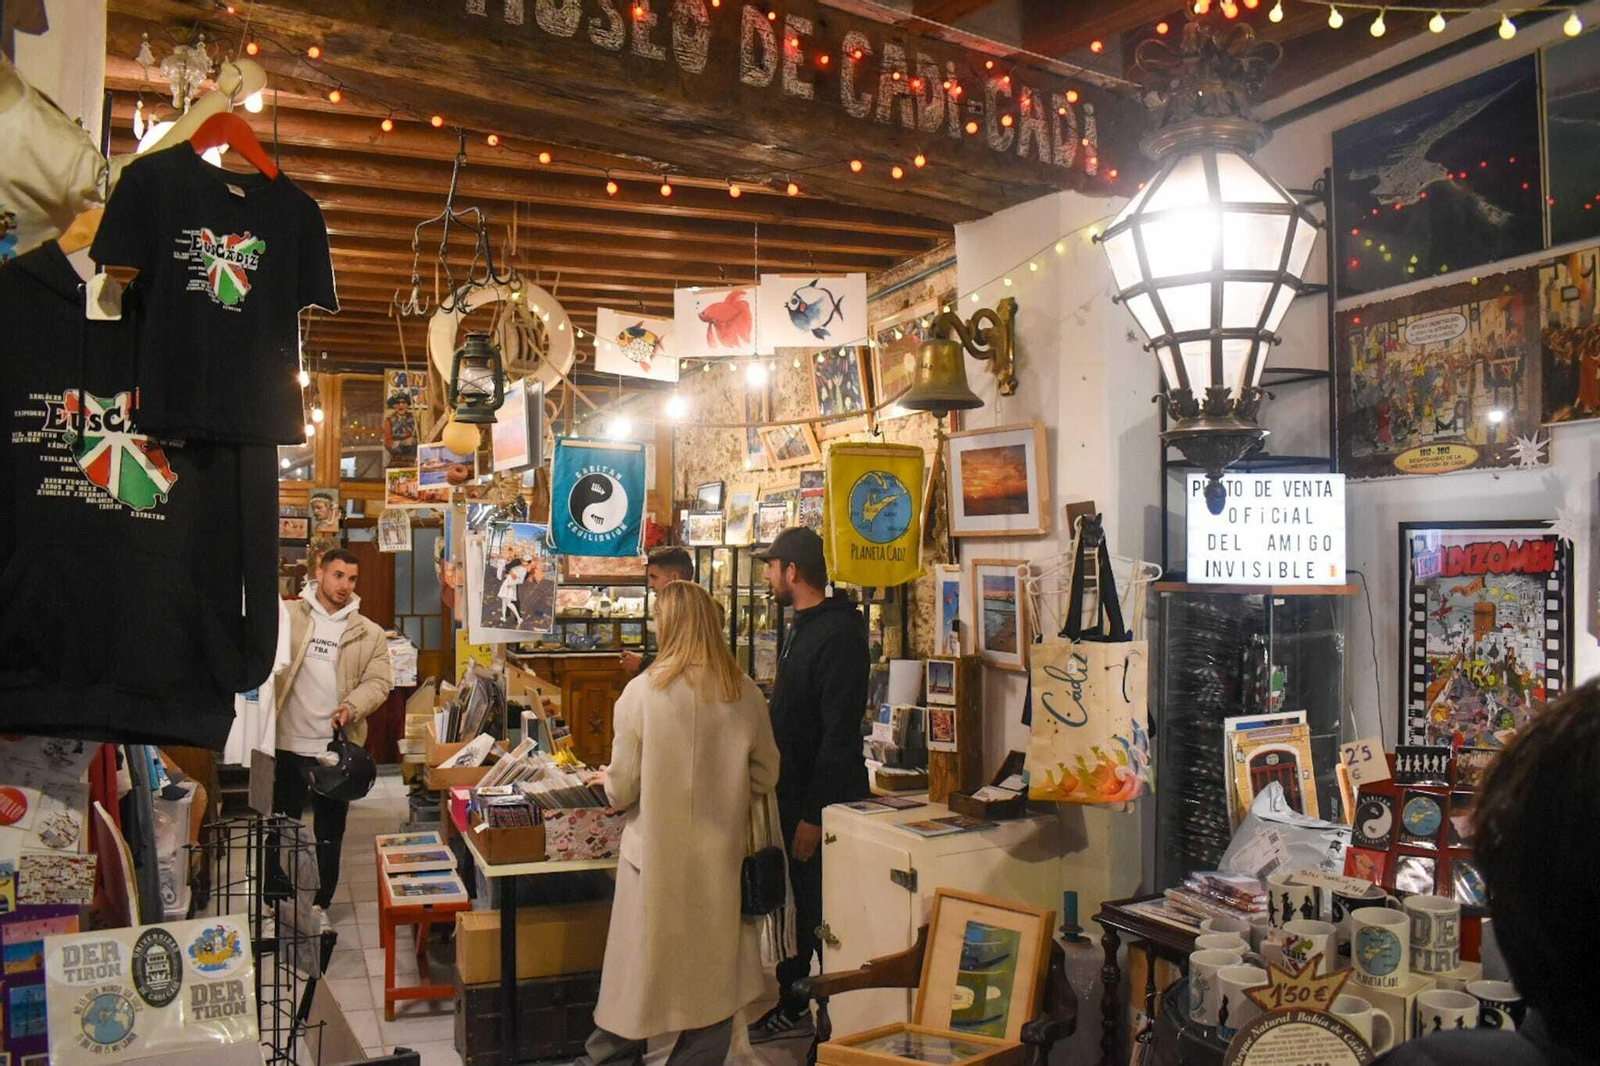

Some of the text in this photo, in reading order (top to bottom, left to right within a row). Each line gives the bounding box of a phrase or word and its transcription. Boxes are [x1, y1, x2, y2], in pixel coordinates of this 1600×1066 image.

[739, 4, 815, 100] DE
[1192, 480, 1333, 498] PTO DE VENTA
[850, 543, 885, 561] PLANETA
[1208, 533, 1332, 552] DEL AMIGO
[1205, 560, 1315, 579] INVISIBLE
[310, 637, 338, 648] AUNCH
[62, 940, 121, 968] DER
[63, 962, 122, 983] TIRON
[190, 979, 245, 1006] DER
[192, 1000, 247, 1020] TIRON
[1250, 1012, 1291, 1038] Natural
[1330, 1023, 1343, 1035] de
